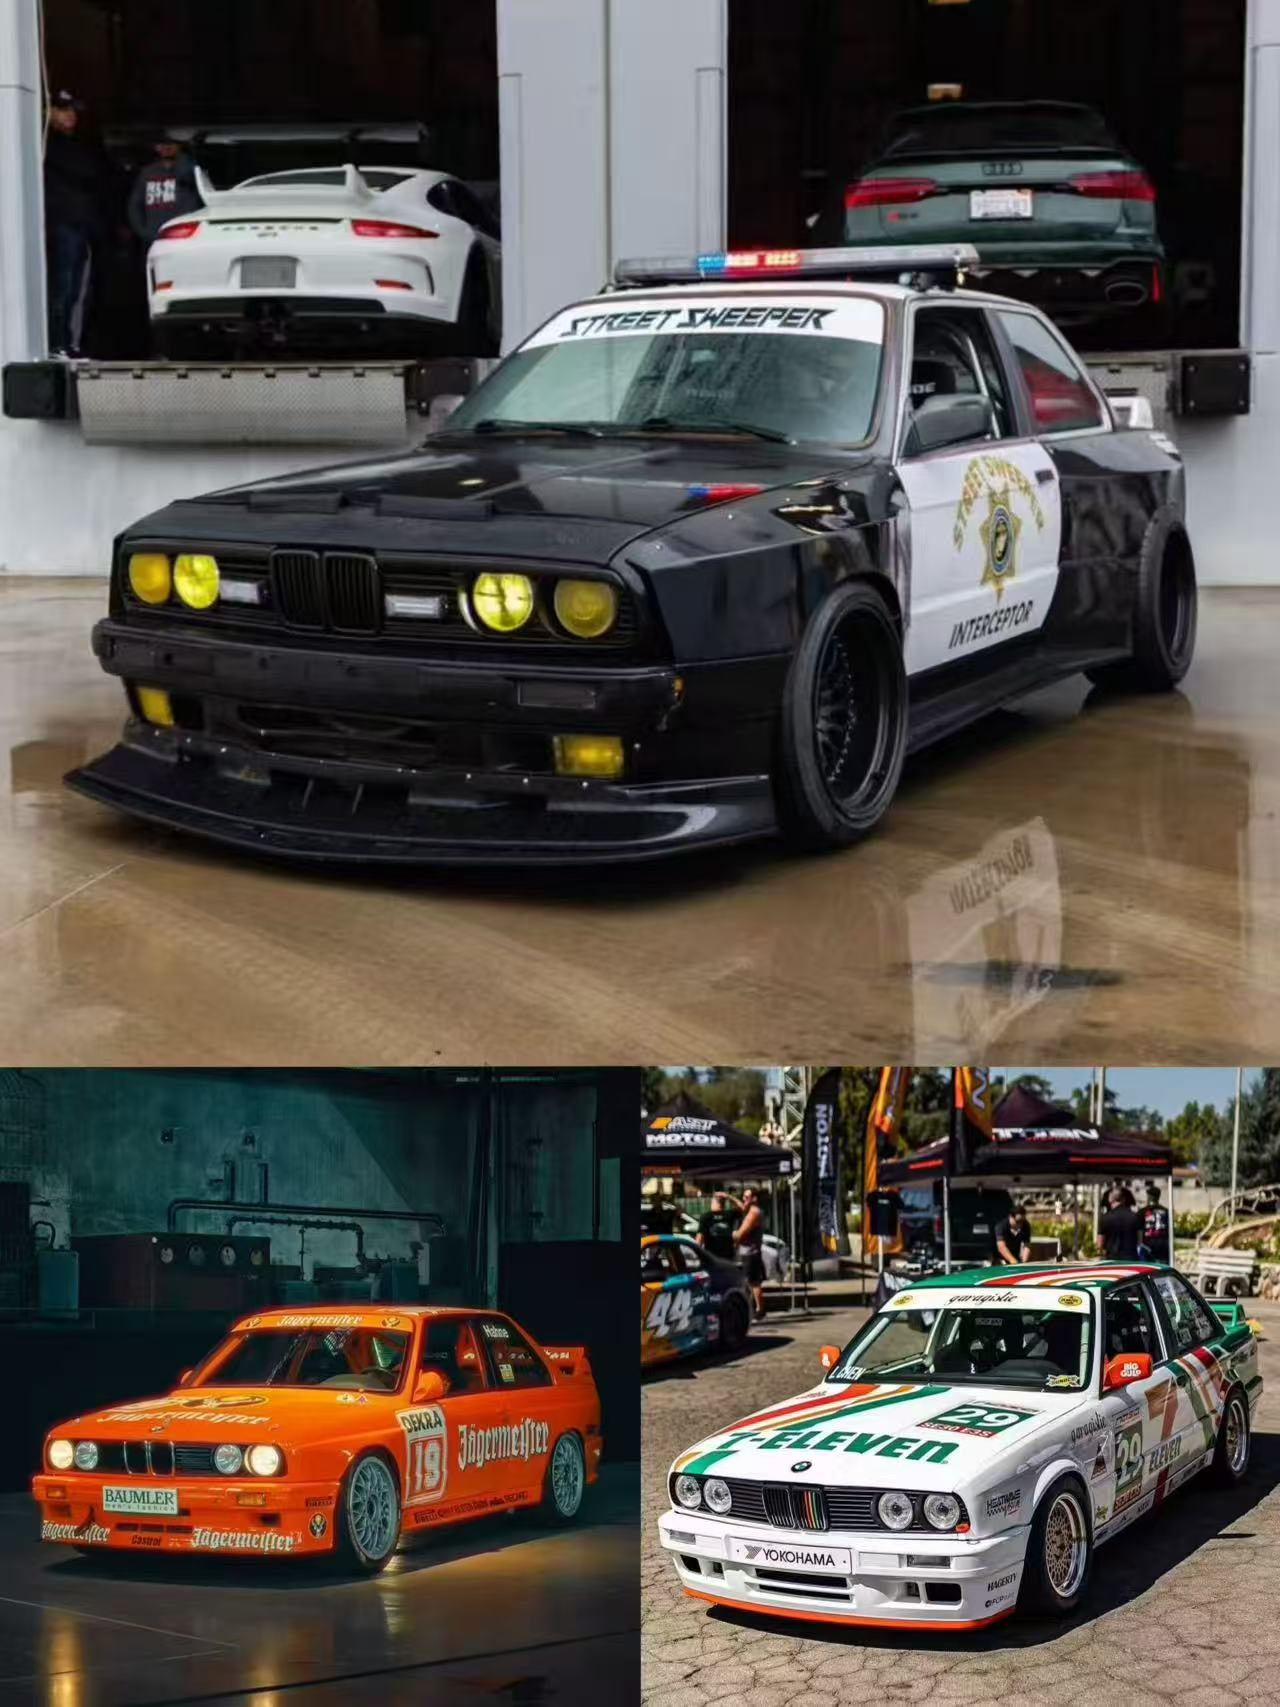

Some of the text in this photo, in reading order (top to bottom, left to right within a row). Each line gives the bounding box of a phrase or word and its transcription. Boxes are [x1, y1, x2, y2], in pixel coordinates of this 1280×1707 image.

[561, 307, 837, 336] STREET SWEEPER
[948, 600, 1034, 649] INTERCEPTOR
[646, 1133, 726, 1147] MOTON
[646, 1289, 693, 1338] 44
[1123, 1362, 1139, 1370] BIG
[401, 1411, 442, 1433] DEKRA
[938, 1408, 1020, 1427] 29
[458, 1417, 549, 1471] Jägermeister
[415, 1440, 441, 1491] 19
[1117, 1432, 1144, 1487] 29
[131, 1533, 162, 1547] Castrol
[191, 1528, 295, 1551] Jägermeister
[763, 1548, 835, 1567] YOKOHAMA
